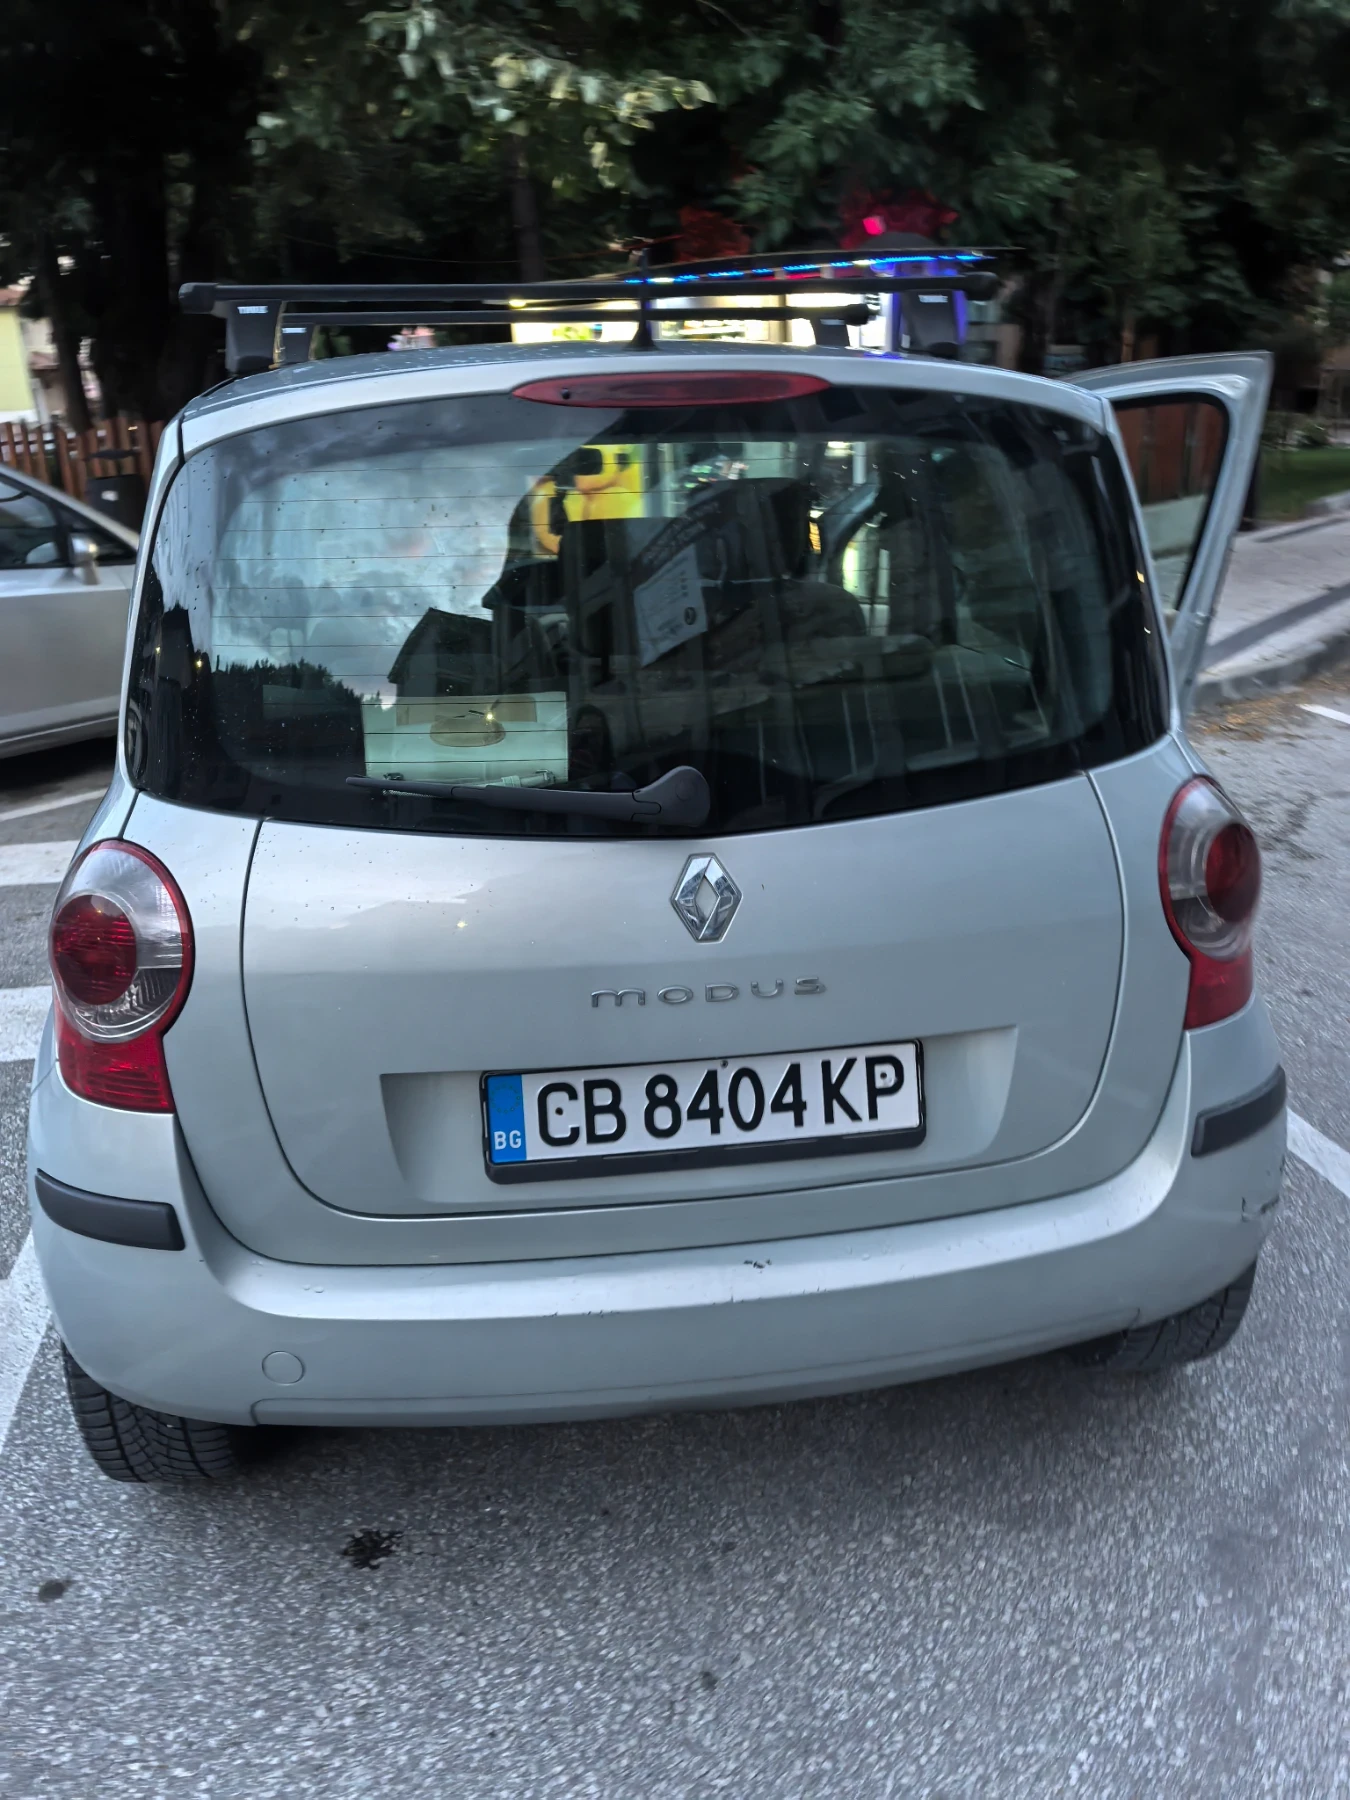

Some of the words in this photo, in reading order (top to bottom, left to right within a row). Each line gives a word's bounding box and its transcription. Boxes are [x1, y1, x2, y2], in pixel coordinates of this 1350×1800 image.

[537, 1079, 626, 1146] CB
[643, 1062, 806, 1139] 8404
[821, 1054, 904, 1124] KP
[493, 1130, 522, 1151] BG
